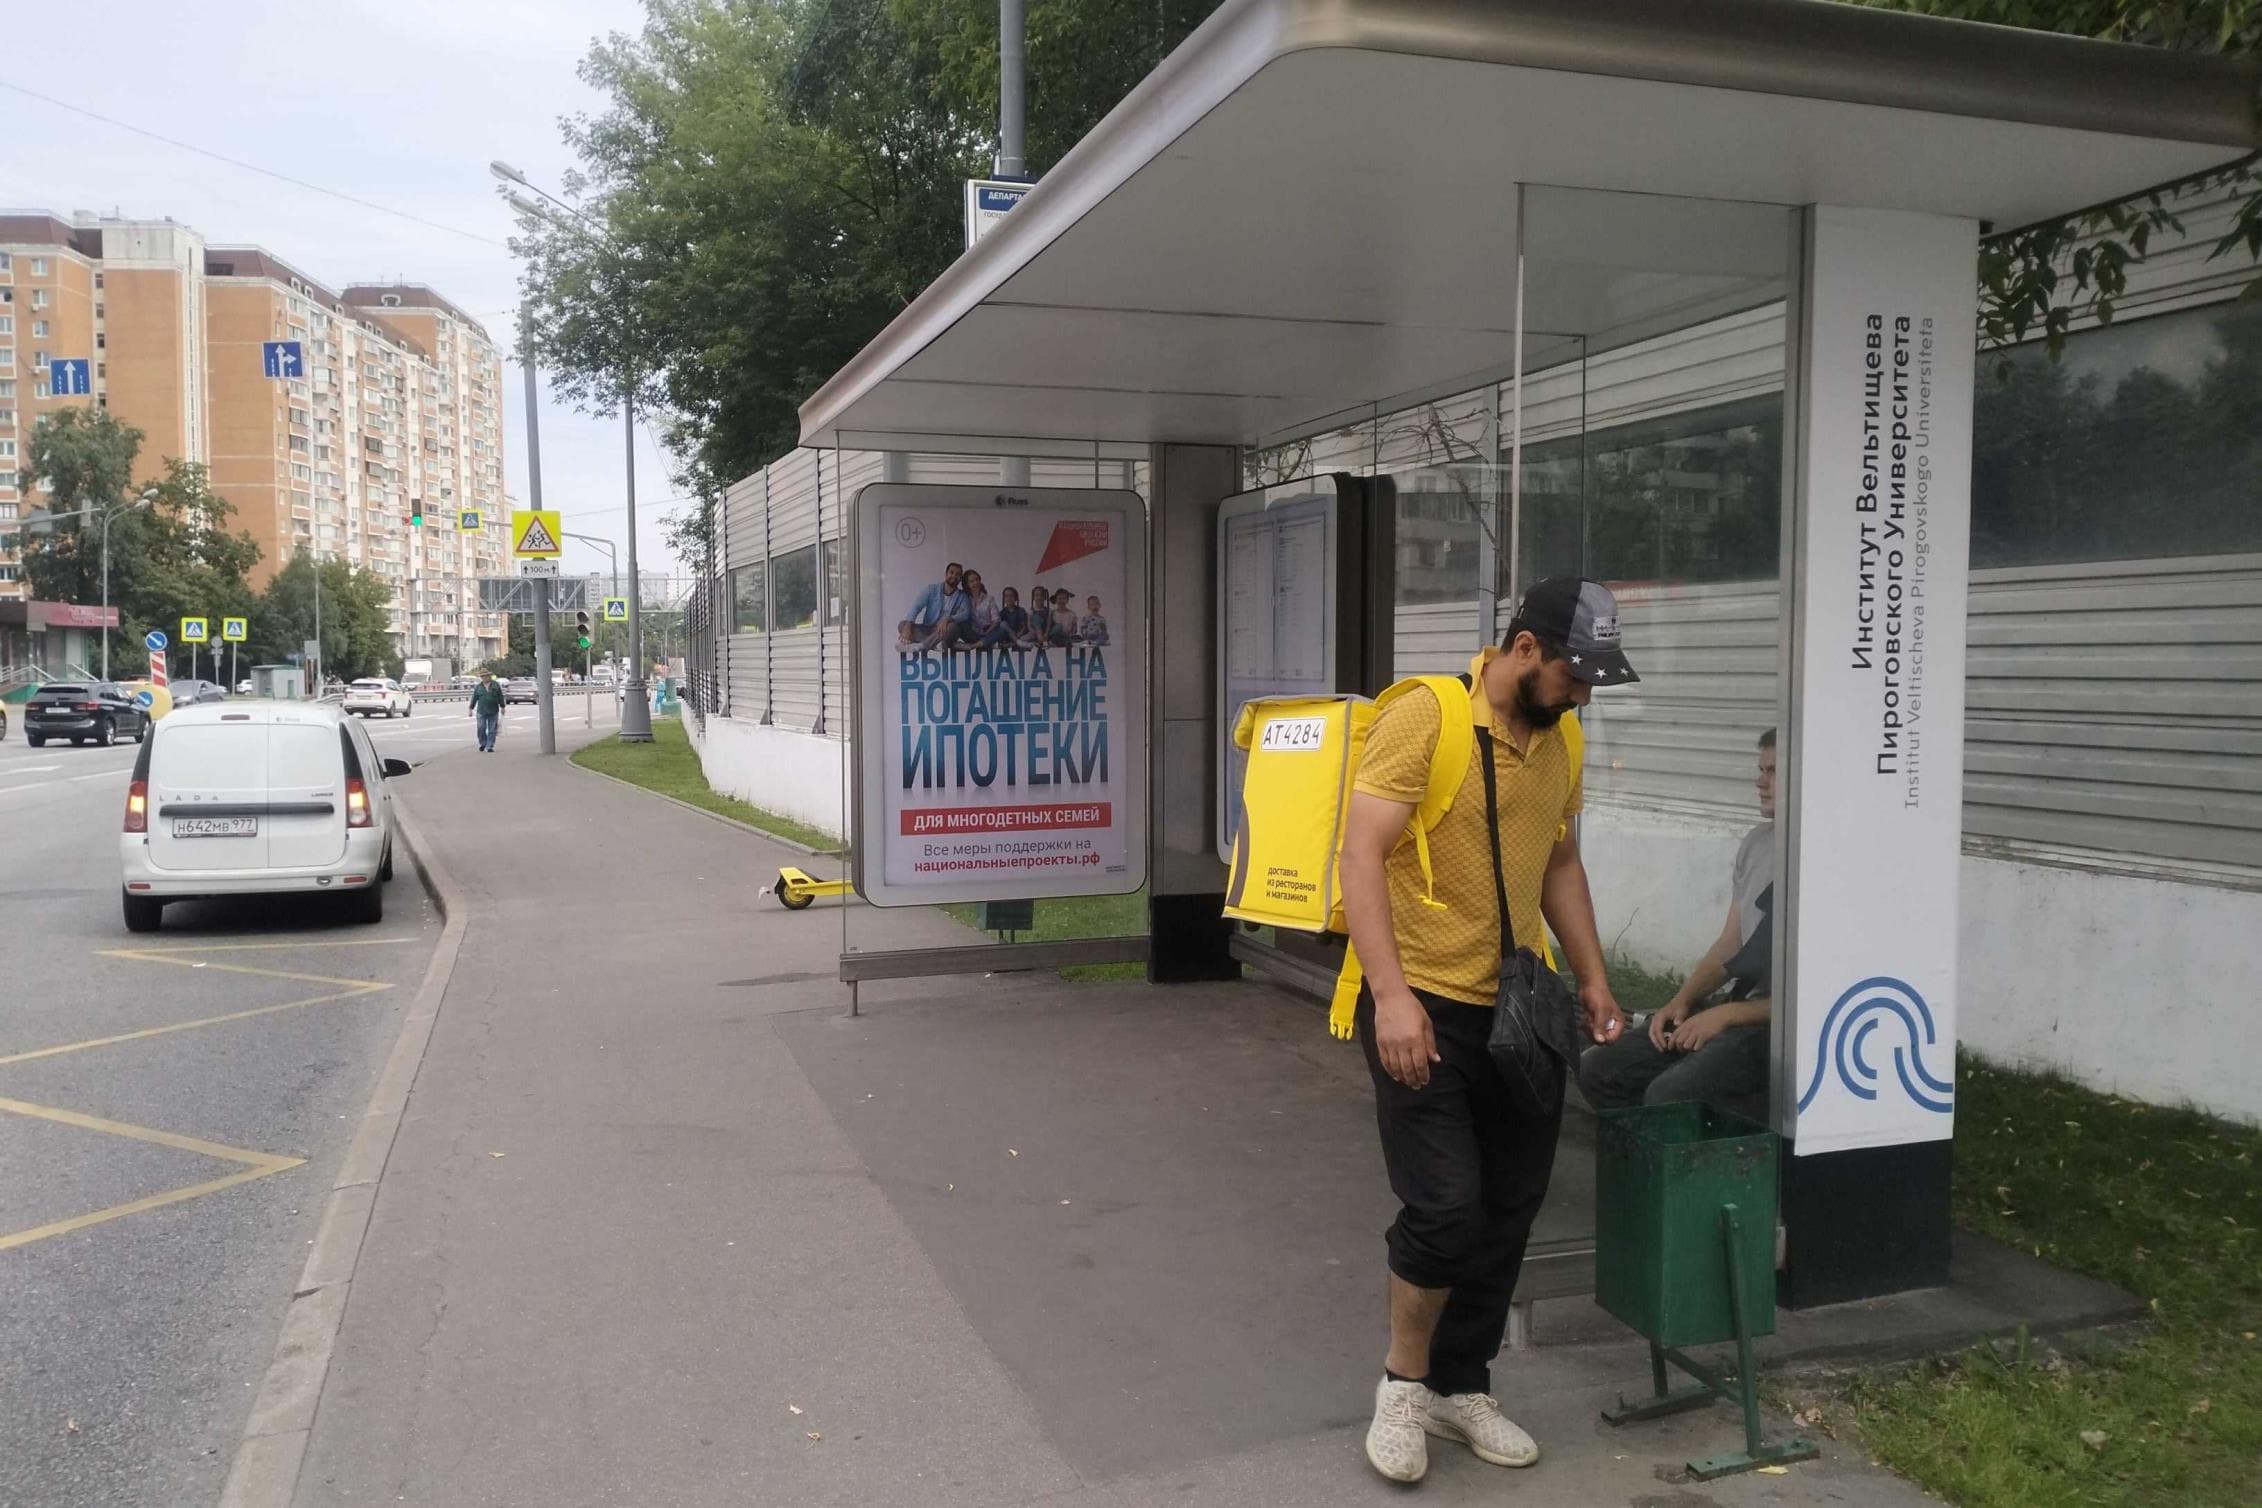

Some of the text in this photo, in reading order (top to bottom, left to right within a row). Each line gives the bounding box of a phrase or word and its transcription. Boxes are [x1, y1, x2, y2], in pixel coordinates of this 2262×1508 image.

[1852, 314, 1884, 668] Институт Вельтищева
[901, 523, 922, 541] 0+
[1877, 316, 1911, 773] Пироговского Университета
[1905, 317, 1933, 808] Institut Veltischeva Pirogovskogo Universiteta
[901, 648, 1107, 680] ВЫПЛАТА НА
[901, 679, 1108, 724] ПОГАШЕНИЕ
[902, 722, 1108, 789] ИПОТЕКИ
[232, 819, 253, 829] 977
[914, 806, 1100, 831] ДЛЯ МНОГОДЕТНЫХ СЕМЕЙ
[924, 839, 1091, 858] Все меры поддержки на
[914, 852, 1100, 873] национальныепроекты.рф
[1268, 867, 1298, 877] доставка
[1272, 891, 1308, 903] магазинов
[1275, 880, 1317, 892] ресторанов
